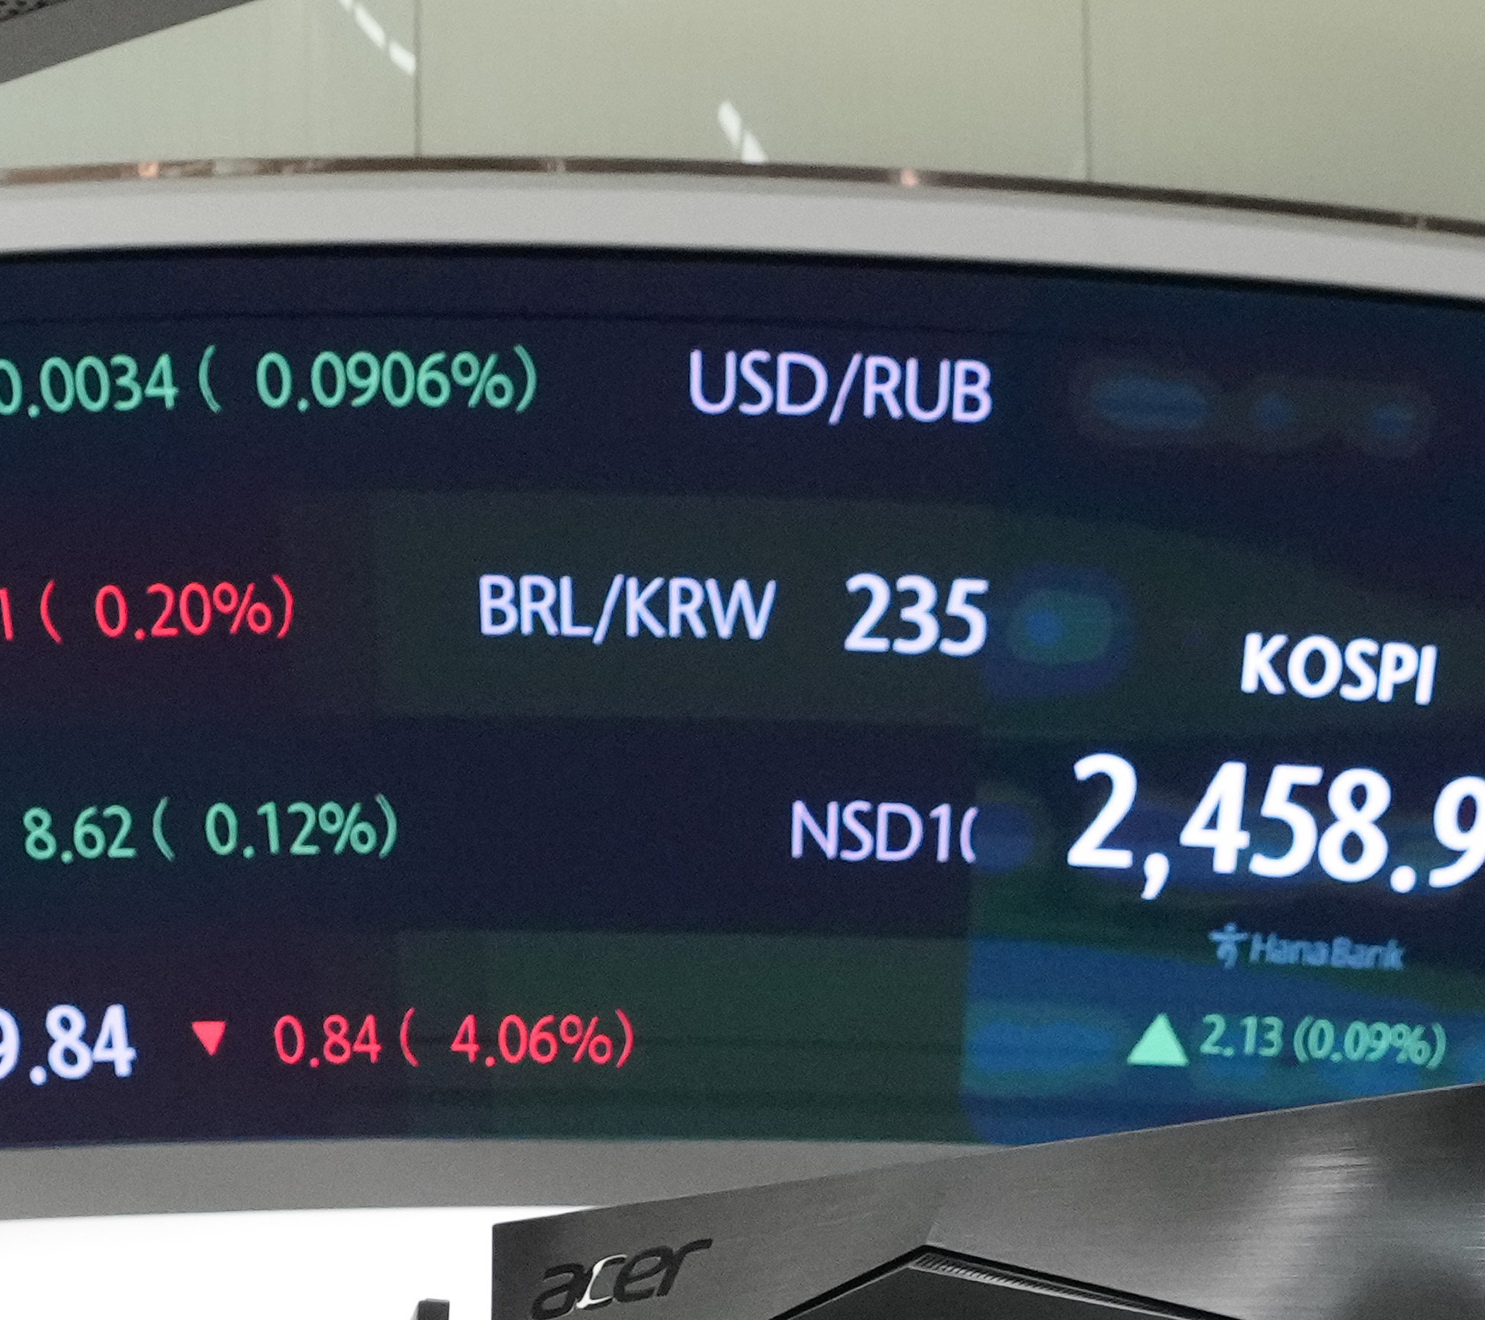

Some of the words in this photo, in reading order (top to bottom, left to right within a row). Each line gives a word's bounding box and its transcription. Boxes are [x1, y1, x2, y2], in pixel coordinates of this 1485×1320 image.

[256, 345, 537, 412] 0.0906%)
[689, 349, 993, 425] USD/RUB
[94, 574, 295, 641] 0.20%)
[478, 573, 777, 645] BRL/KRW
[843, 572, 990, 658] 235
[1240, 631, 1438, 706] KOSPI
[23, 804, 136, 863] 8.62
[205, 794, 397, 859] 0.12%)
[273, 1014, 383, 1068] 0.84
[450, 1009, 634, 1068] 4.06%)
[1199, 1013, 1283, 1059] 2.13
[1293, 1016, 1446, 1068] (0.09%)
